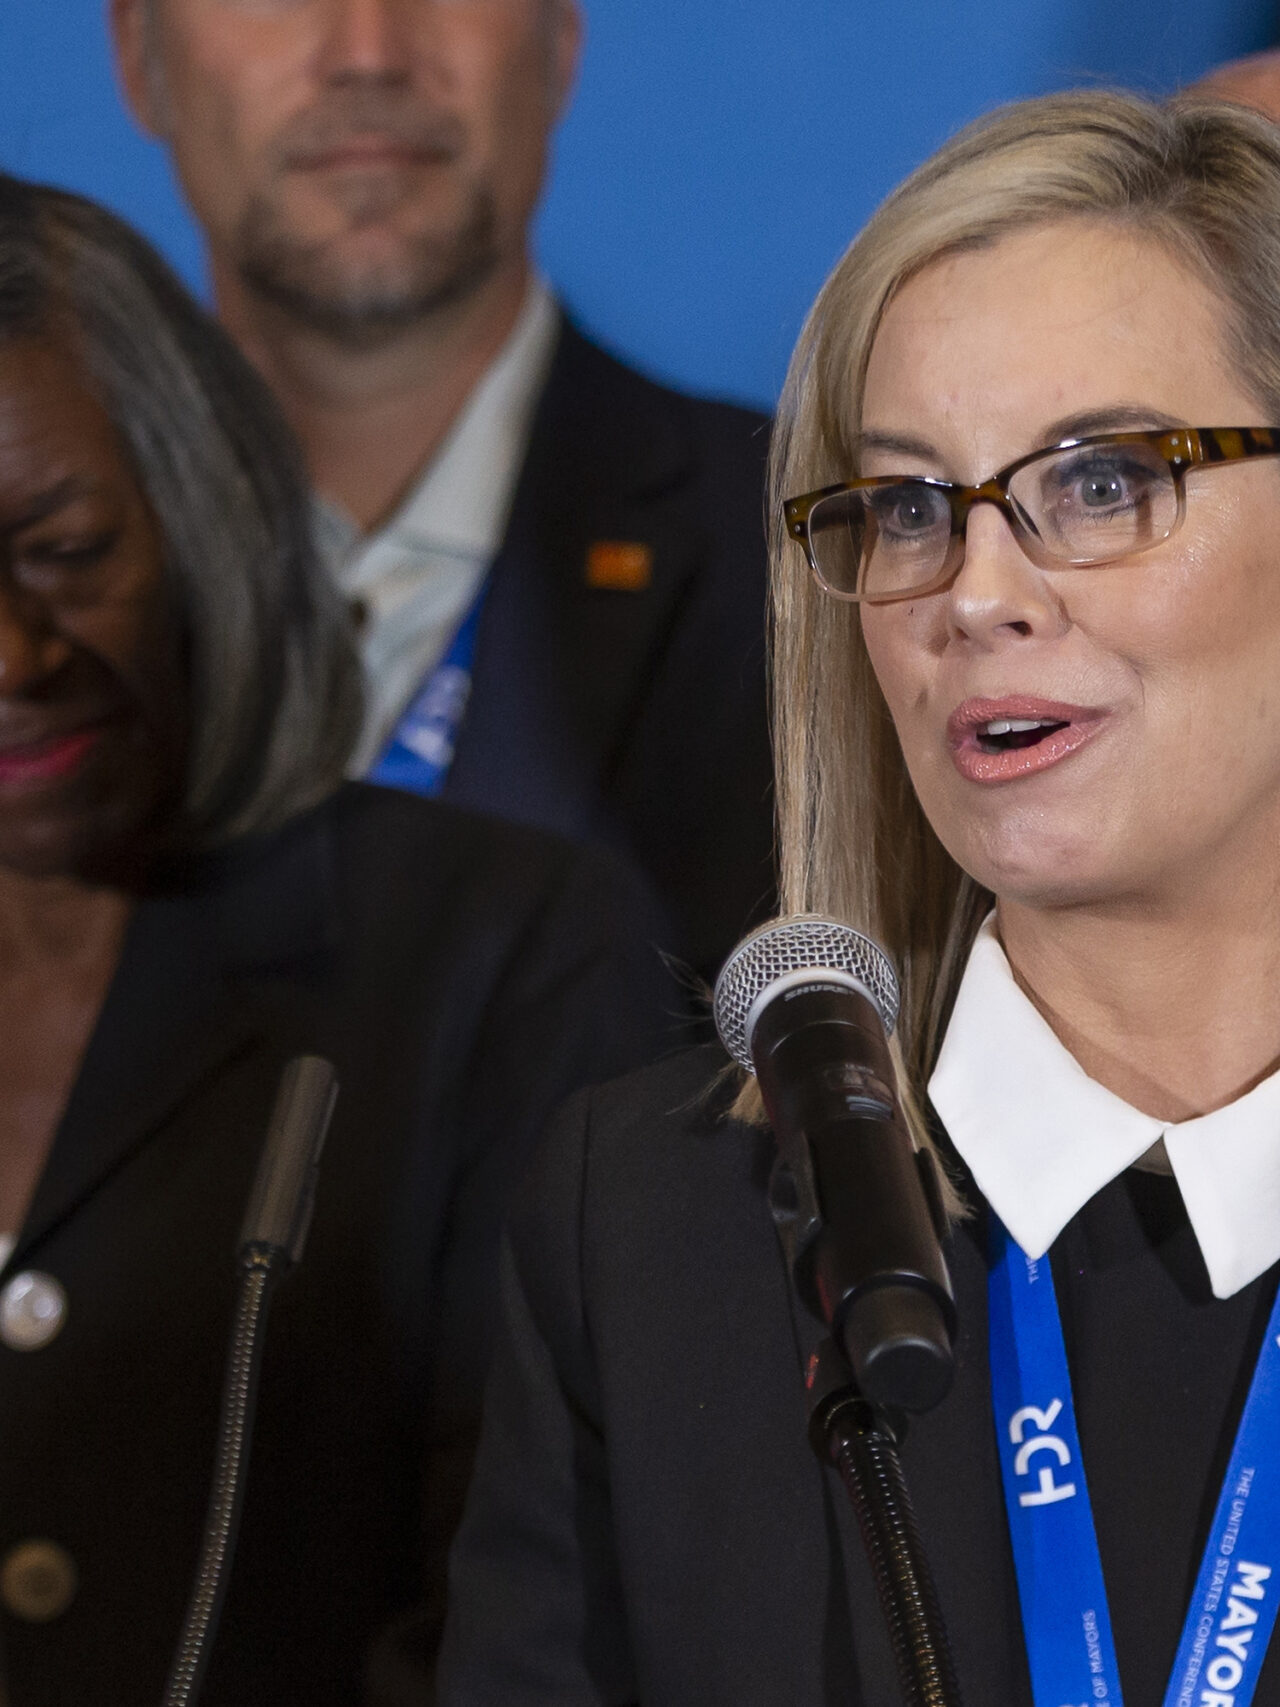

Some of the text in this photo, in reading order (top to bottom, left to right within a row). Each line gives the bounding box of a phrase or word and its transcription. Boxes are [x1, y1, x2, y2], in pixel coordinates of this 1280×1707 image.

[1237, 1467, 1255, 1498] THE
[1220, 1500, 1246, 1555] UNITED
[1204, 1558, 1230, 1612] STATES
[1082, 1609, 1104, 1674] MAYORS
[1092, 1677, 1108, 1698] OF
